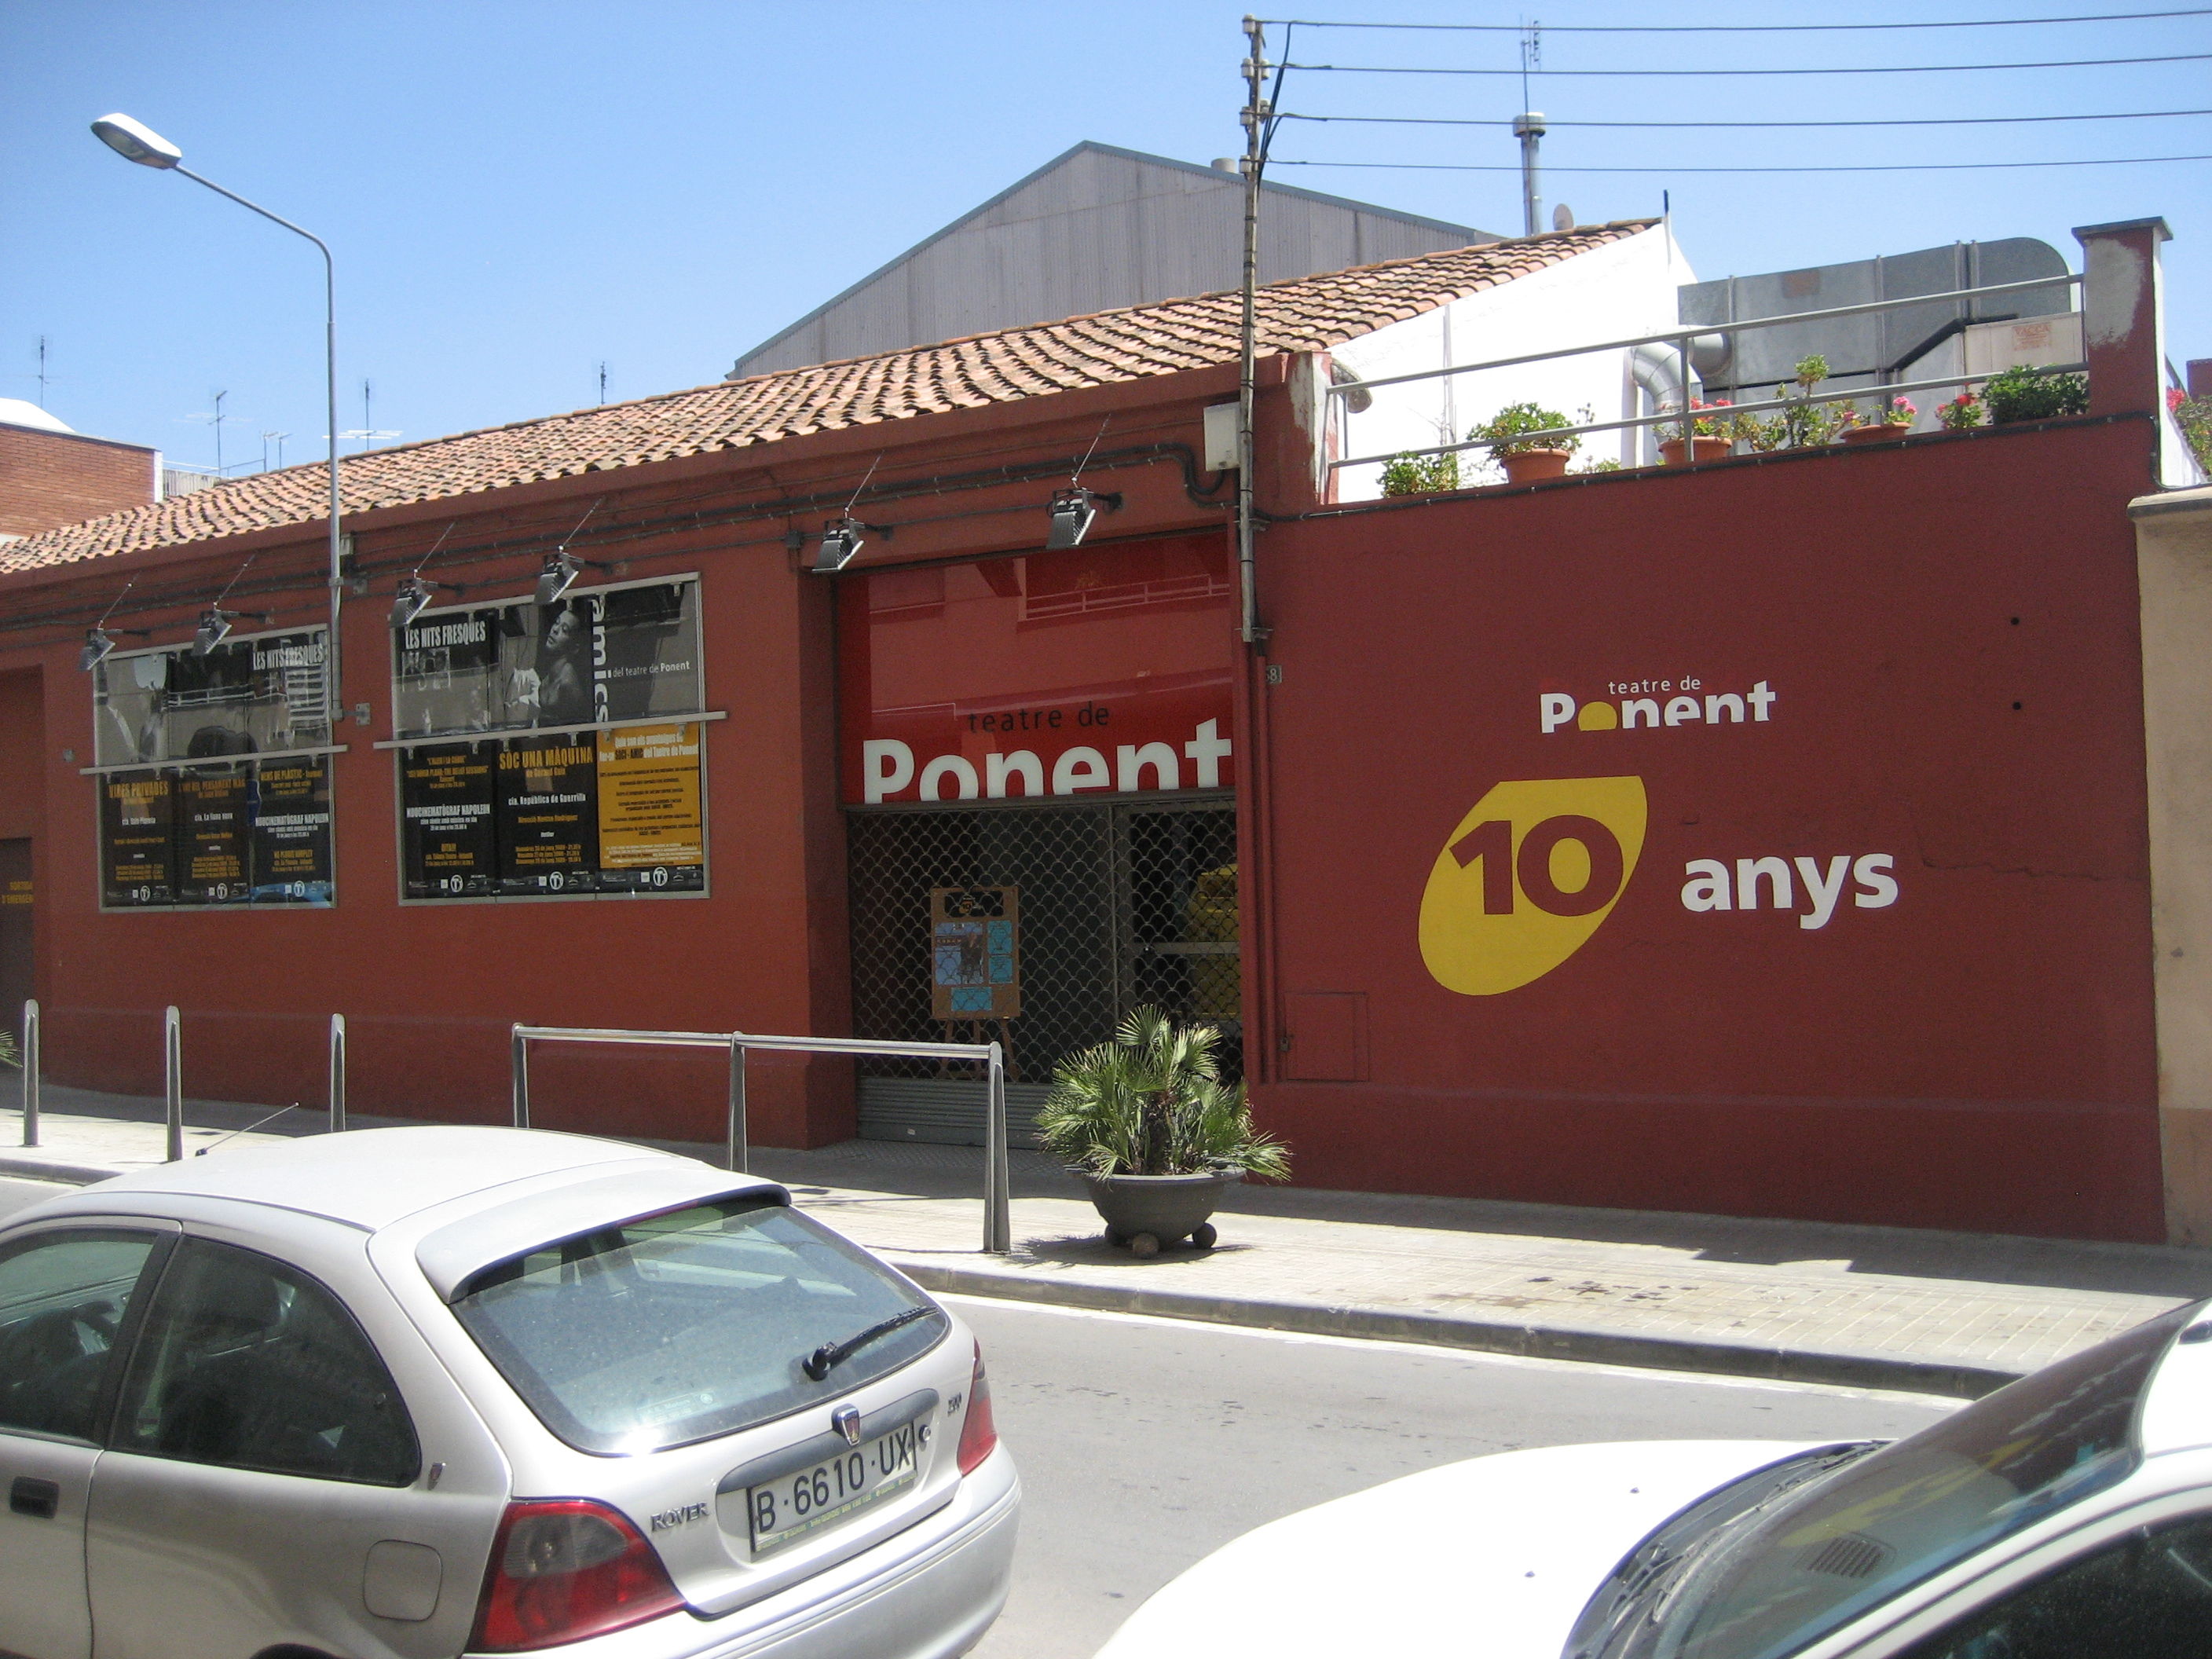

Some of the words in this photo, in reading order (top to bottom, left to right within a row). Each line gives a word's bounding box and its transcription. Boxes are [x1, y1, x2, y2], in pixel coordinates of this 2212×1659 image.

[405, 628, 419, 650] LES
[421, 626, 441, 647] NITS
[442, 621, 485, 645] FRESQUES
[253, 651, 266, 670] LES
[661, 661, 690, 672] Ponent
[1608, 679, 1670, 694] teatre
[1680, 676, 1701, 690] de
[968, 708, 1062, 733] teatre
[1079, 700, 1108, 727] de
[1540, 680, 1776, 734] Ponent
[522, 750, 543, 767] UNA
[546, 745, 592, 767] MÀQUINA
[862, 717, 1232, 804] Ponent
[1449, 815, 1624, 917] 10
[1681, 853, 1899, 930] anys
[650, 1501, 709, 1532] ROVER
